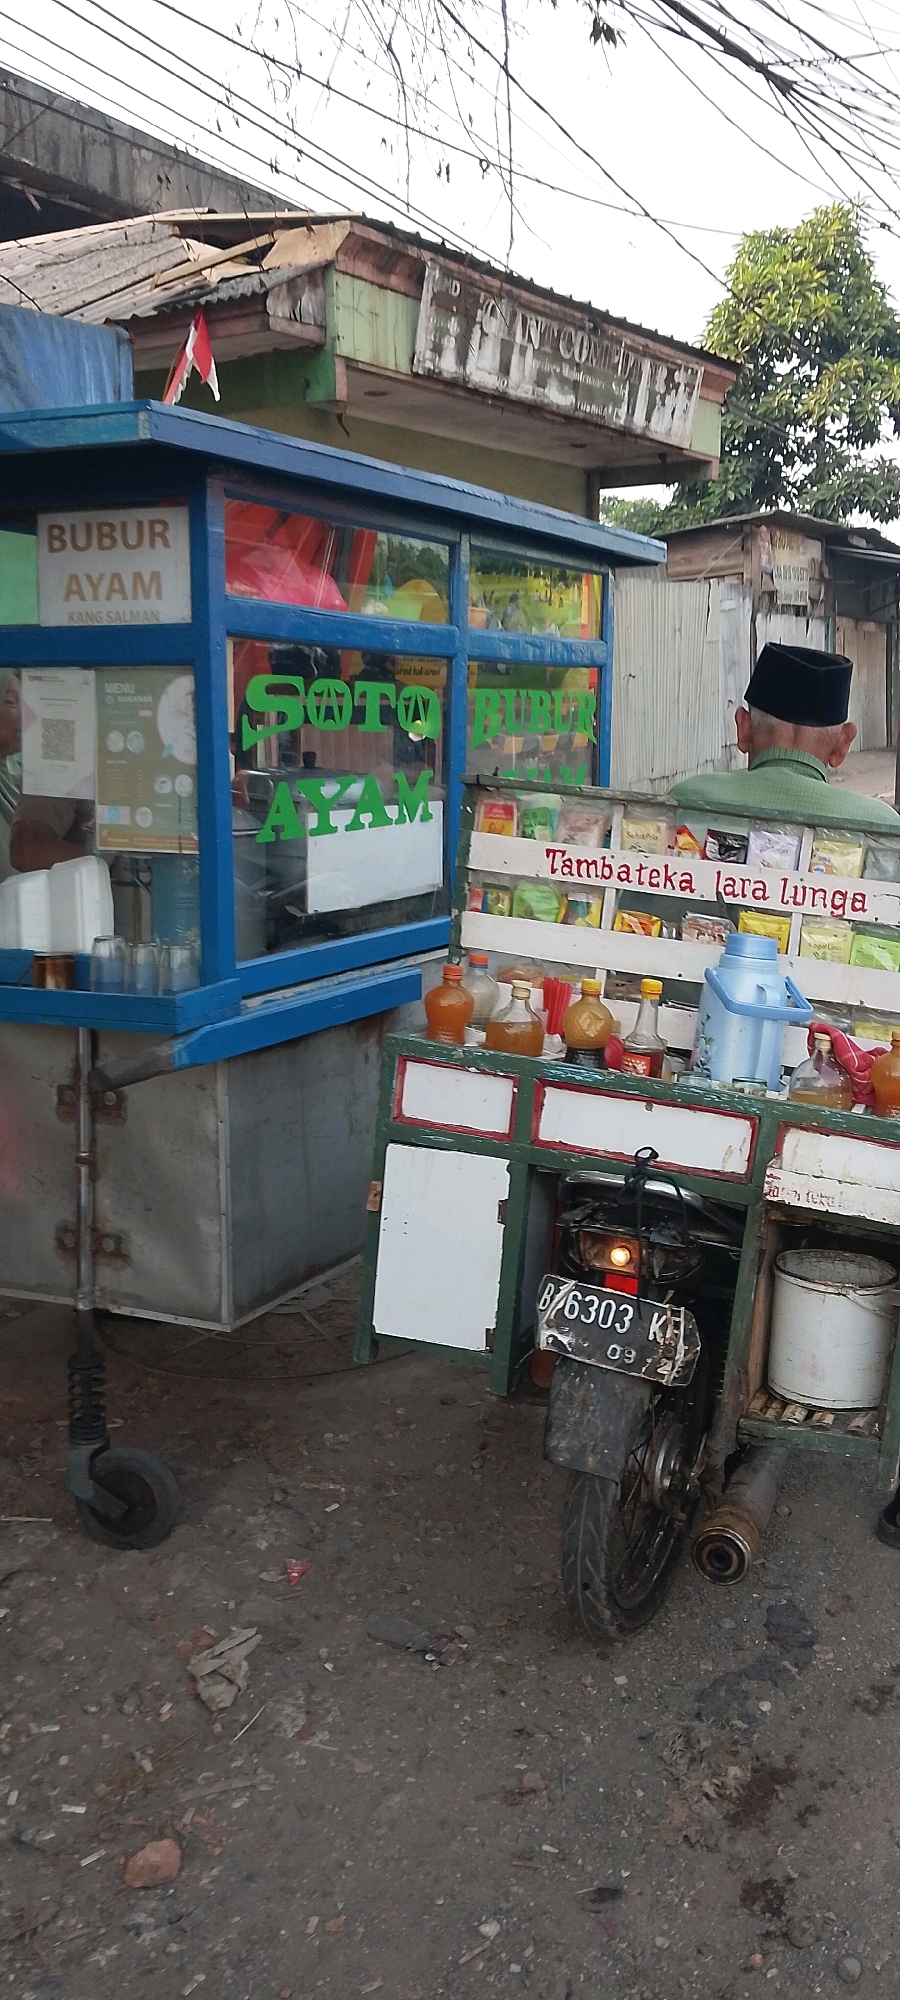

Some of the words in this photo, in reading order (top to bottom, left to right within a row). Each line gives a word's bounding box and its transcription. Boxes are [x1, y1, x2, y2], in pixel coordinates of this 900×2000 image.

[47, 519, 170, 553] BUBUR
[63, 571, 163, 602] AYAM
[67, 610, 104, 624] KANG
[106, 609, 160, 623] SALMAN
[242, 674, 441, 750] SOTO
[470, 688, 598, 749] BUBUR
[256, 770, 434, 843] AYAM
[545, 848, 698, 895] Tambateka
[715, 869, 770, 902] lara
[780, 876, 868, 918] lunga
[538, 1282, 556, 1311] B
[563, 1290, 634, 1334] 6303
[606, 1344, 637, 1365] 09
